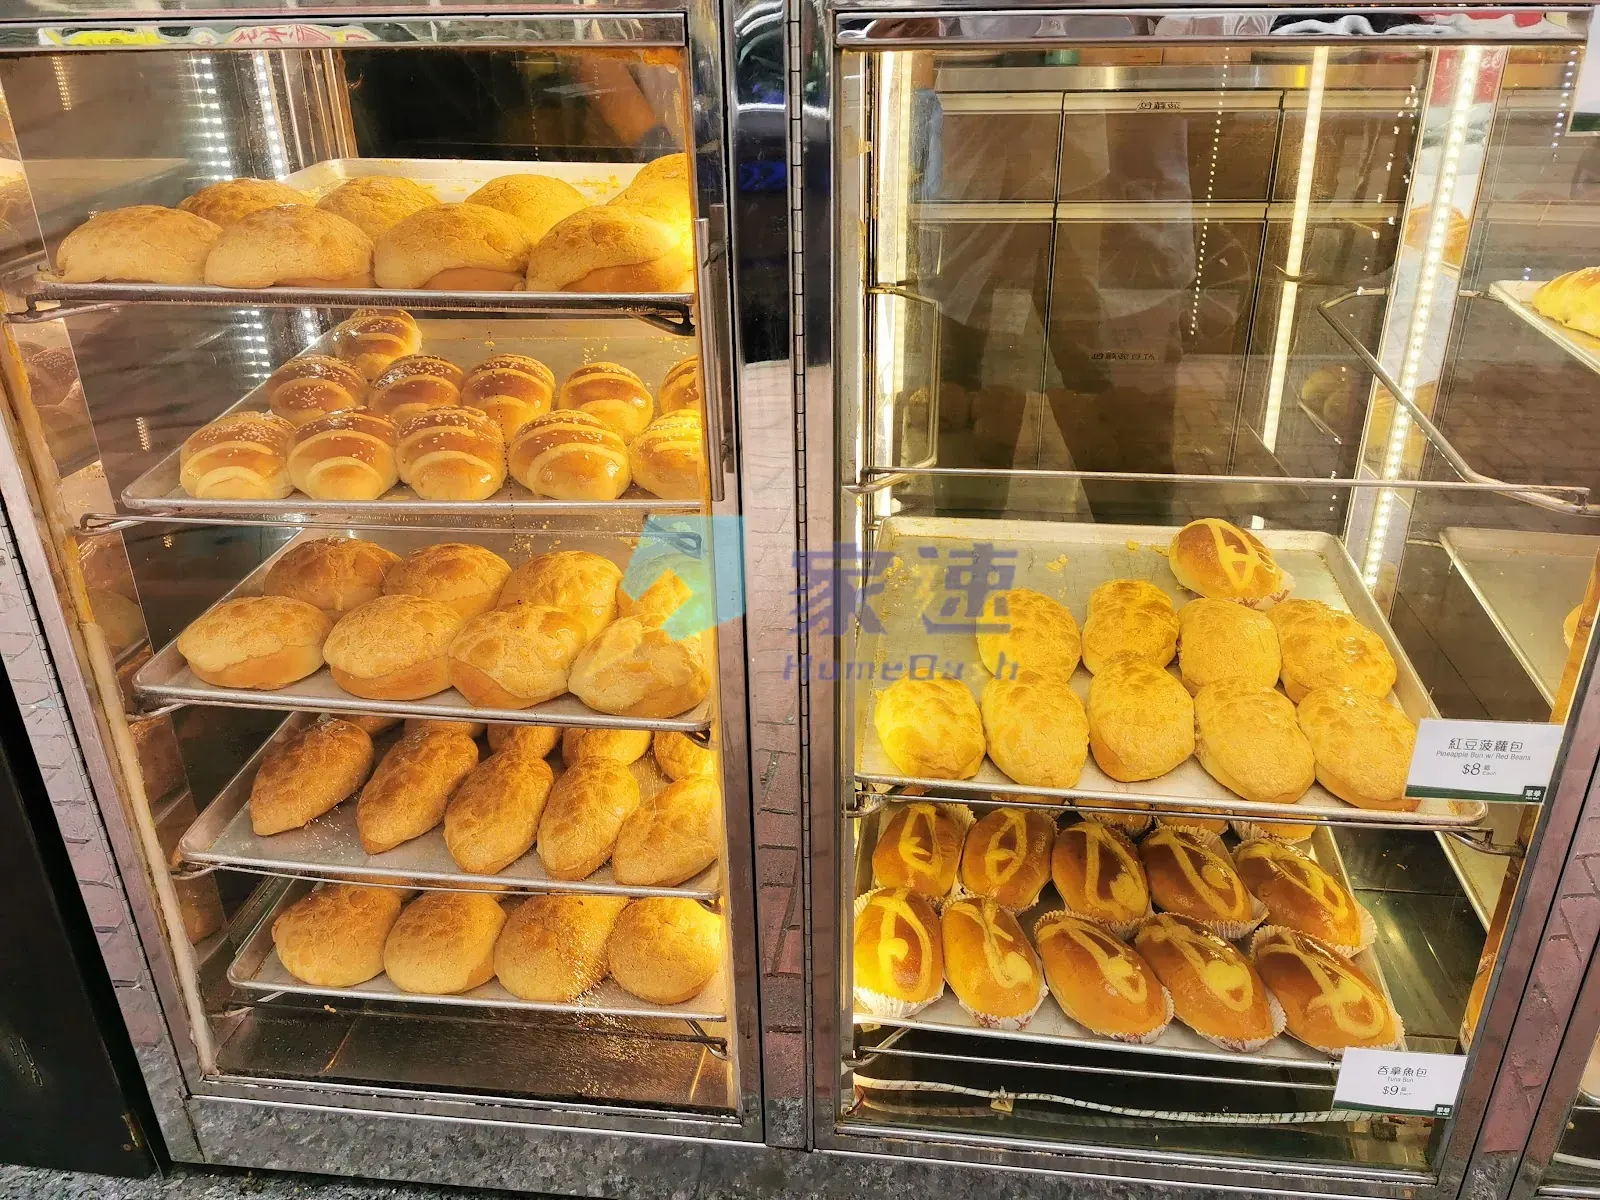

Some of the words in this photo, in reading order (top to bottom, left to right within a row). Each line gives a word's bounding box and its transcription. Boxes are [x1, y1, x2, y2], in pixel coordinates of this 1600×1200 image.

[1448, 738, 1523, 752] 紅豆菠蘿包
[1436, 750, 1469, 759] Pineapple
[1461, 762, 1481, 776] $8
[1382, 1085, 1399, 1096] $9
